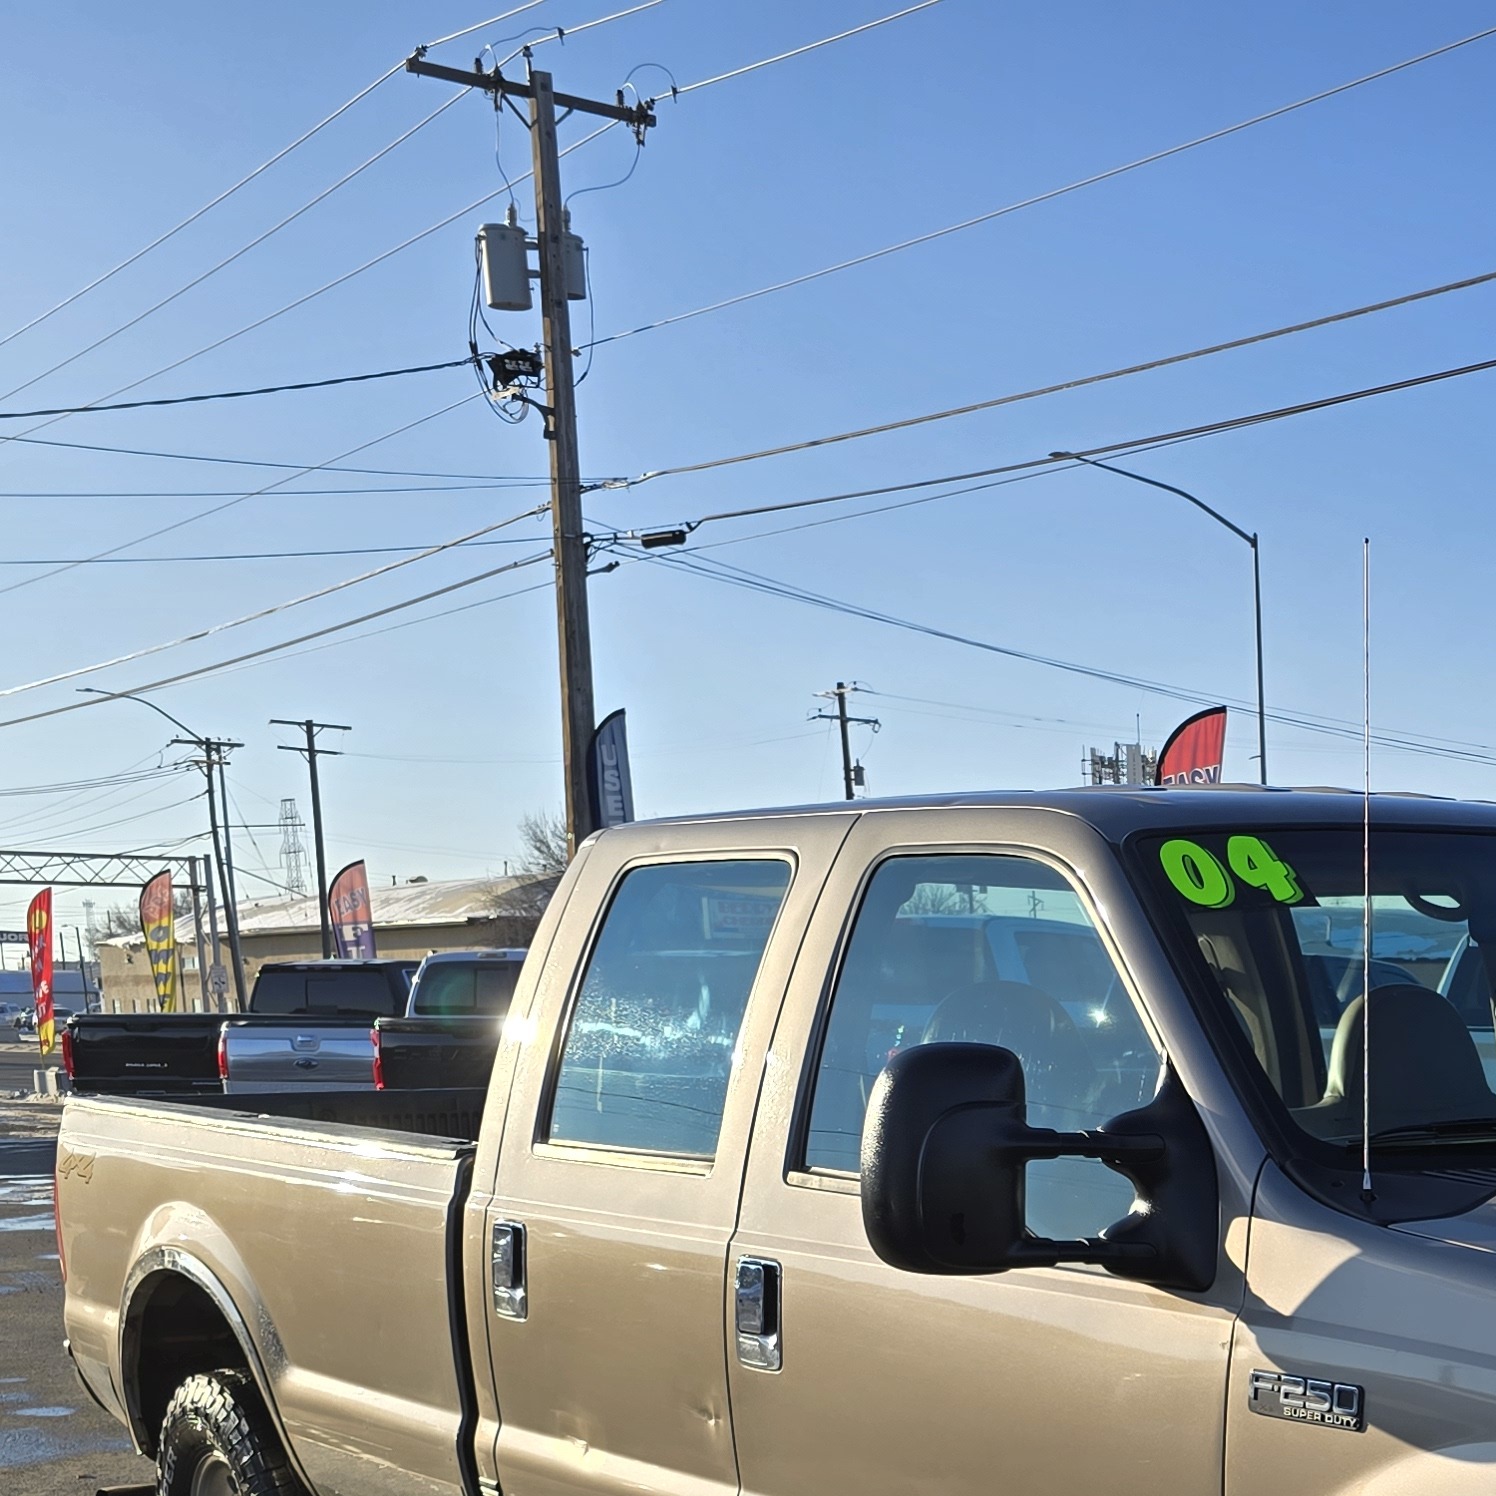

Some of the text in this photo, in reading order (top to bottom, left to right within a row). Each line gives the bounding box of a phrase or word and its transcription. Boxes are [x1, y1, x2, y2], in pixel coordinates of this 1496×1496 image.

[601, 744, 625, 827] USE
[1159, 834, 1304, 909] 04
[334, 887, 368, 917] EASY
[1283, 1406, 1357, 1428] SUPER DUTY
